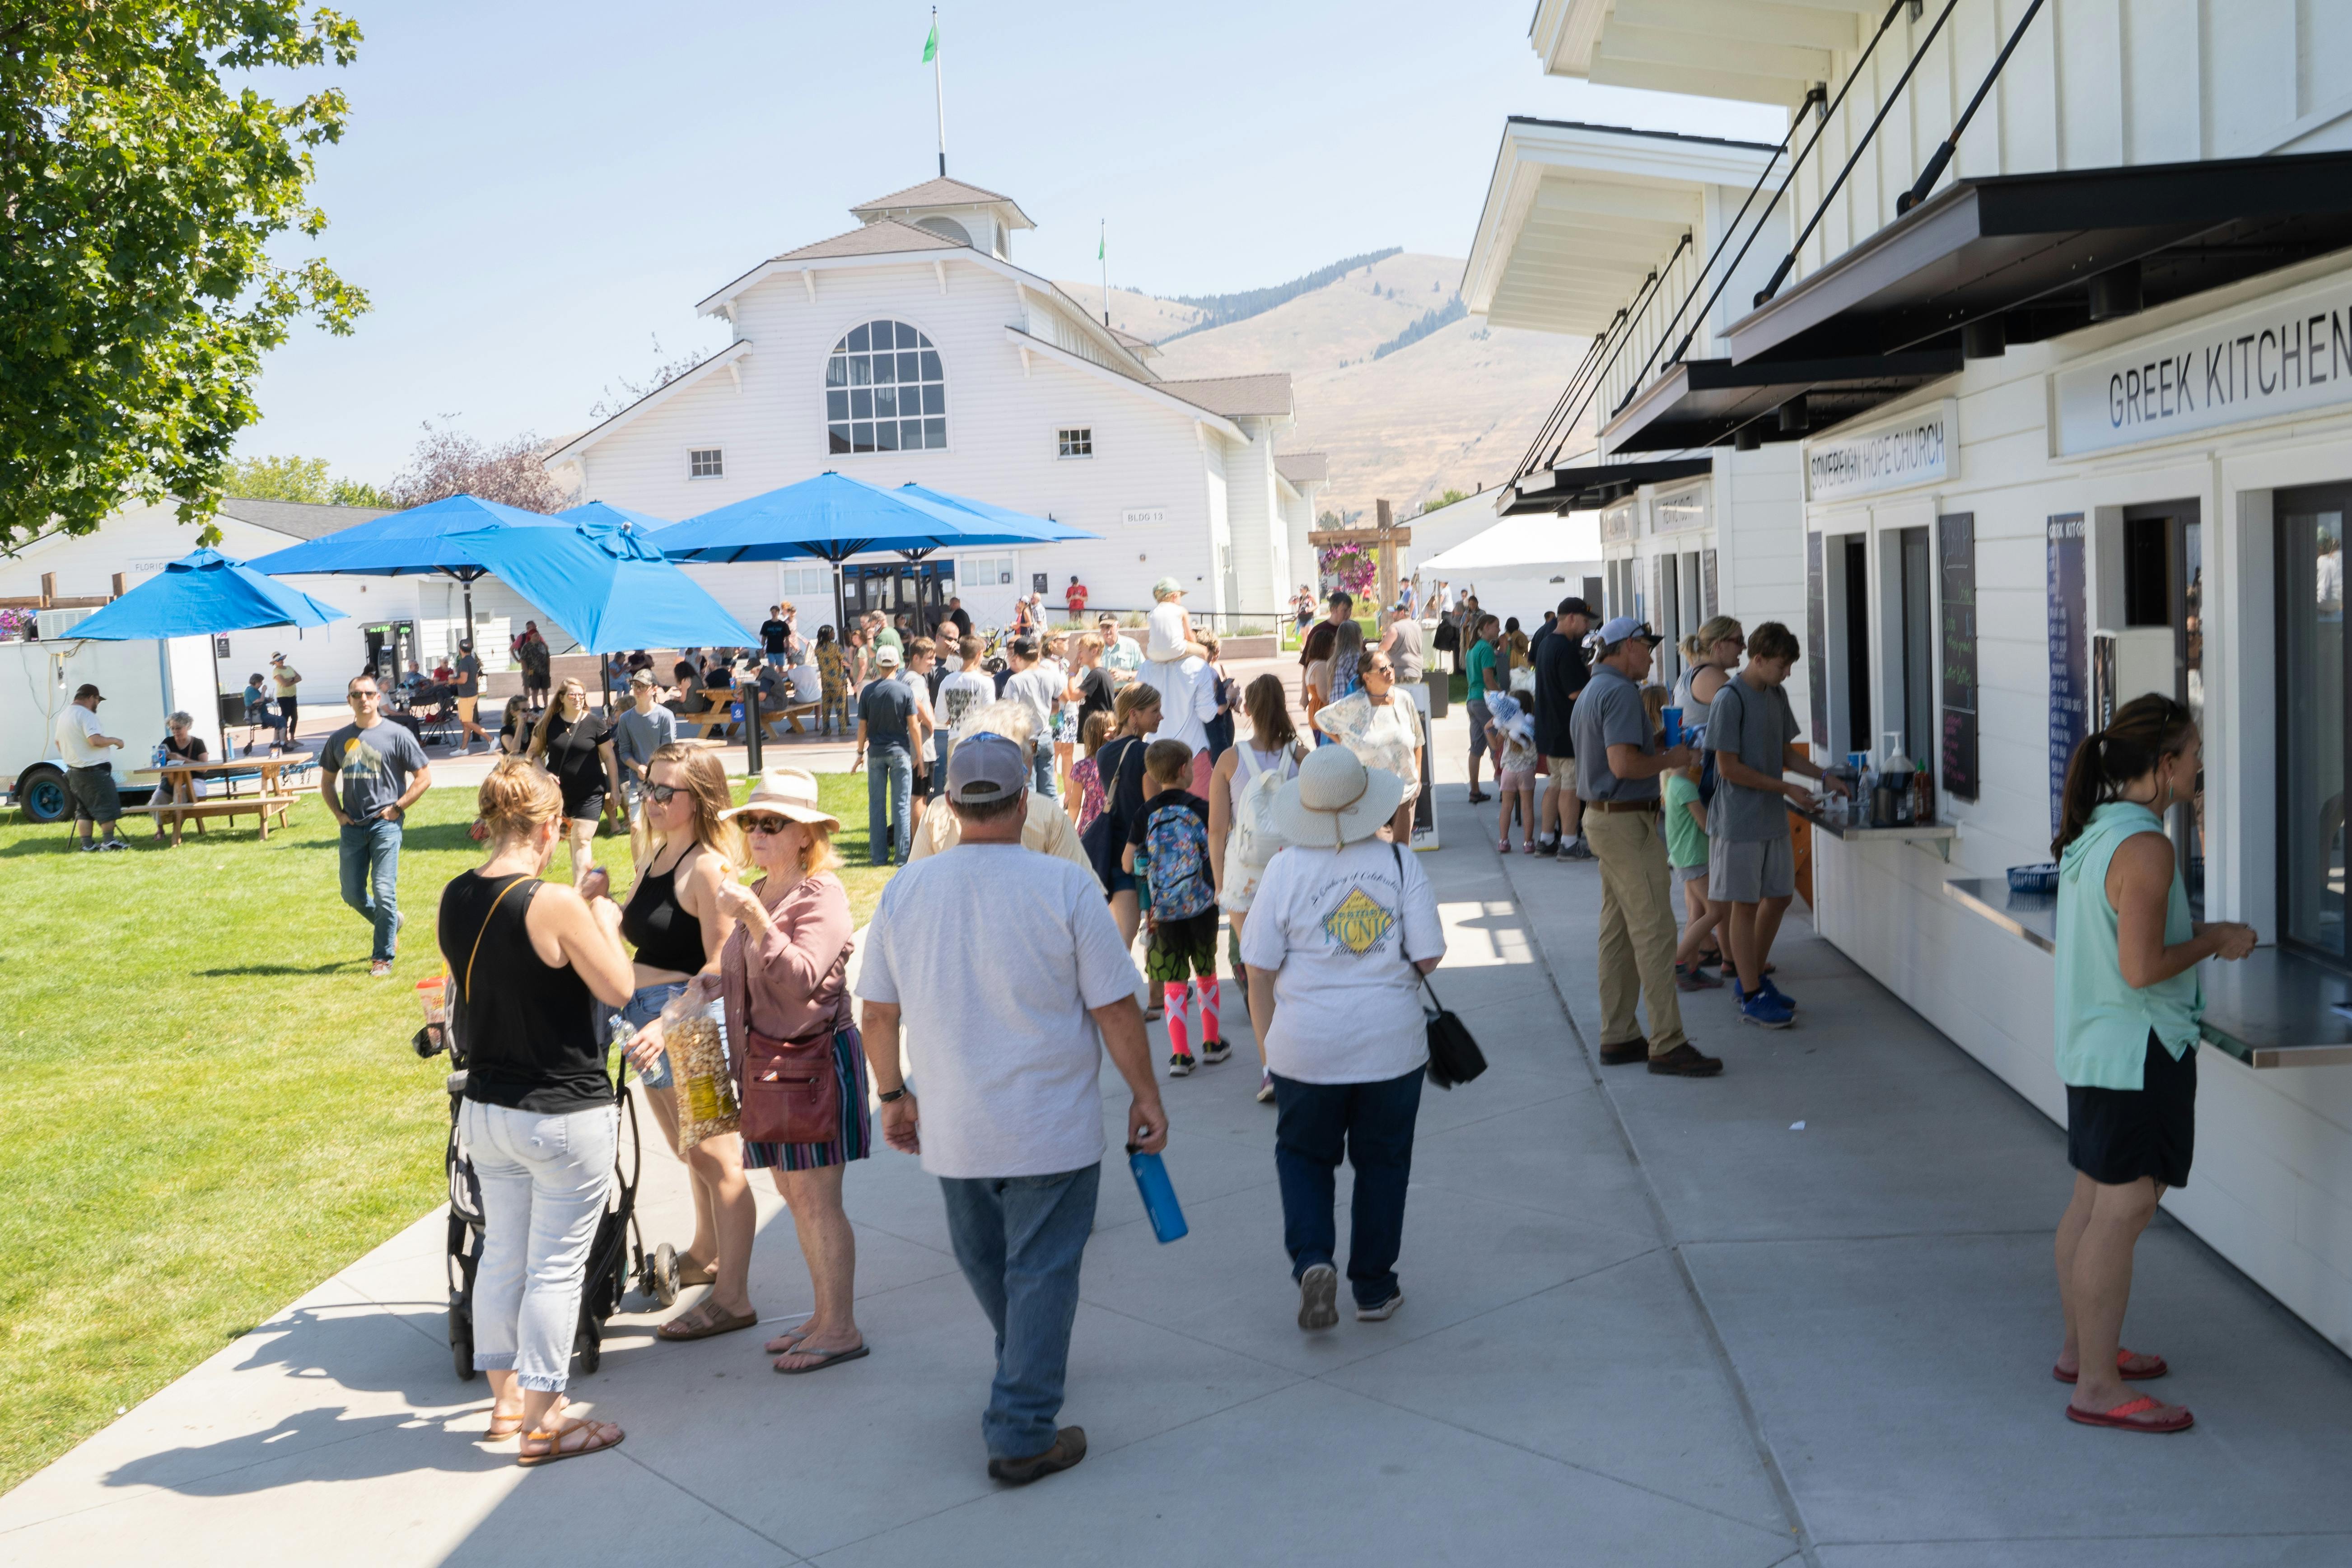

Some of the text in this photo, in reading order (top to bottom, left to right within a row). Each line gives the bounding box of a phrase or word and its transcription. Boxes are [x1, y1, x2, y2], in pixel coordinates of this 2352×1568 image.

[2109, 304, 2352, 429] GREEK KITCHEN
[1811, 420, 1945, 490] SOVEREIGN HOPE CHURCH
[1128, 512, 1163, 522] BLDG 13
[135, 562, 166, 571] FLORIC
[400, 633, 410, 673] ATM
[1324, 916, 1395, 945] PICNIC
